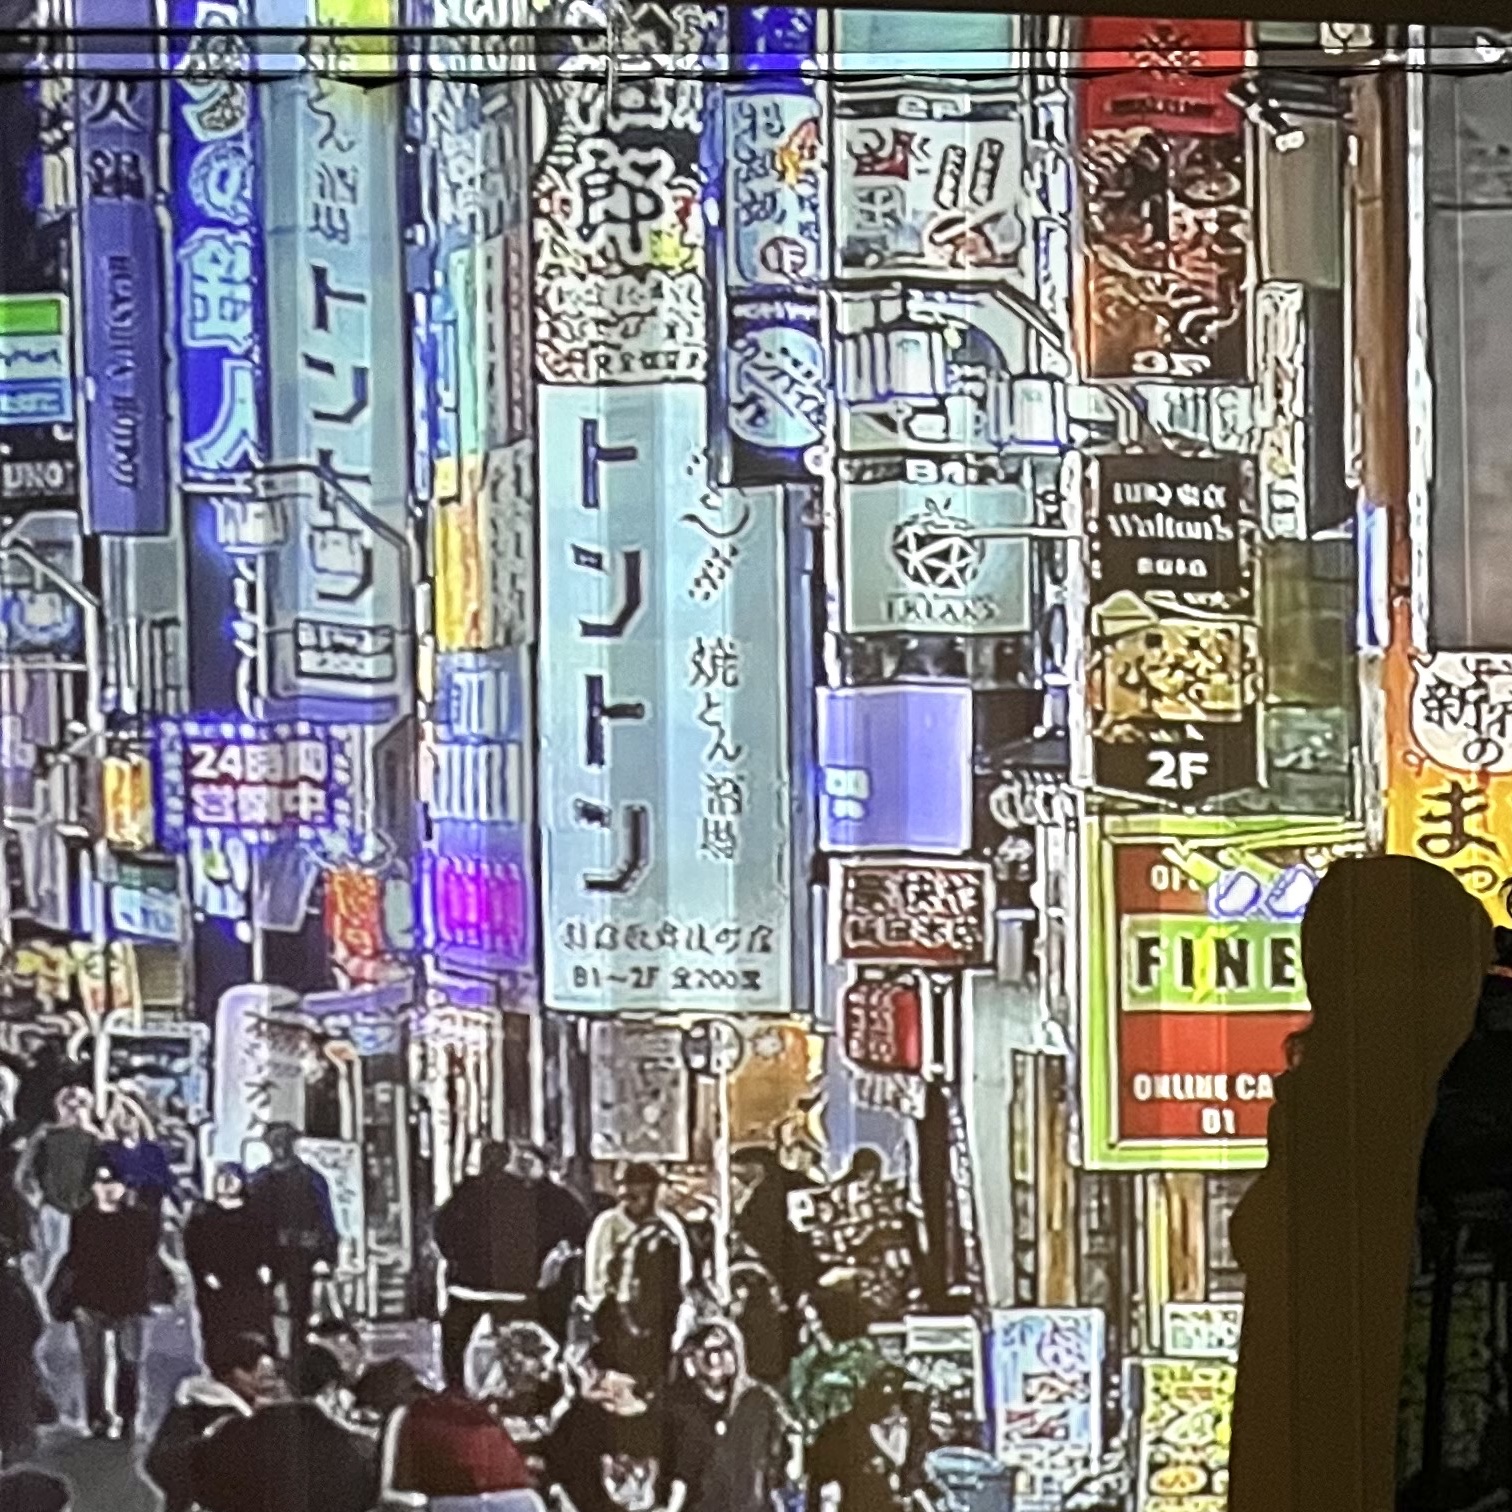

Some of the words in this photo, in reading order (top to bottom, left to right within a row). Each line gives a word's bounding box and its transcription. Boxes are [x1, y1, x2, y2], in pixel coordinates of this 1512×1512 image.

[571, 416, 650, 895] トントン
[1146, 750, 1209, 789] 2F
[1463, 737, 1504, 765] の
